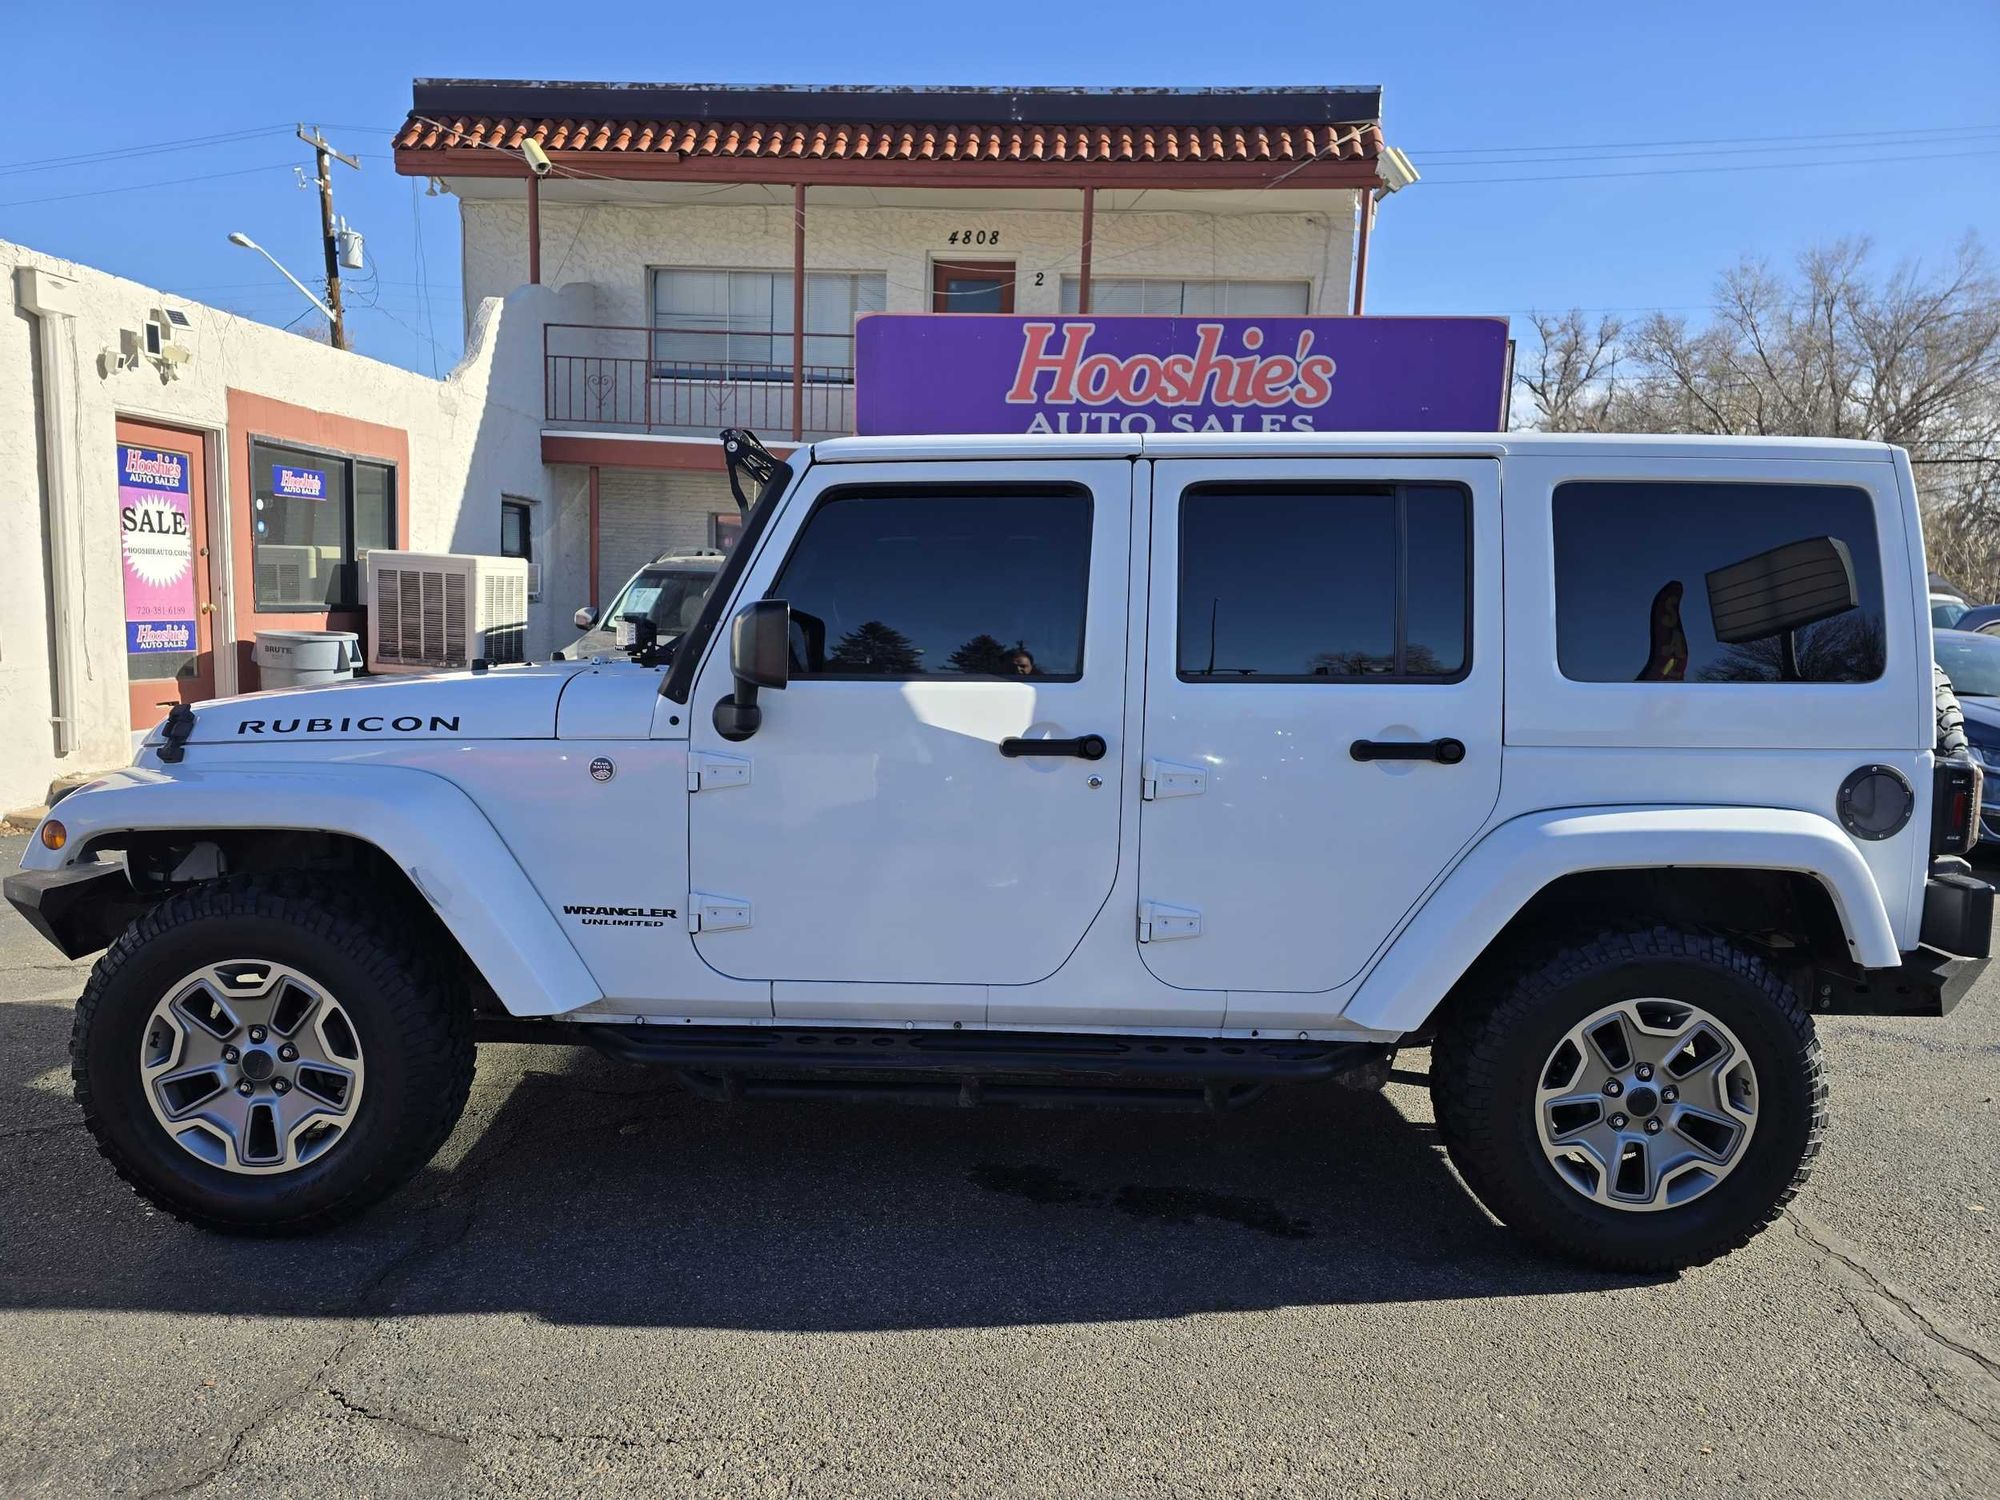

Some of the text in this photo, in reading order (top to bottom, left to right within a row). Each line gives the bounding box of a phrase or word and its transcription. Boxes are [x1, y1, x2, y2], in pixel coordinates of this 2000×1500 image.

[948, 230, 1000, 245] 4808
[1034, 272, 1045, 287] 2
[1005, 322, 1336, 409] Hooshie's
[1025, 411, 1316, 434] AUTO SALES
[126, 449, 182, 479] Hooshie's
[130, 473, 180, 487] AUTO SALES
[283, 486, 320, 496] AUTO SALES
[122, 507, 187, 536] SALE
[137, 624, 190, 643] Hooshie's
[140, 640, 187, 649] AUTO SALES
[264, 644, 296, 655] BRUTE
[237, 716, 460, 735] RUBICON
[563, 906, 678, 919] WRANGLER
[582, 919, 664, 927] UNLIMITED
